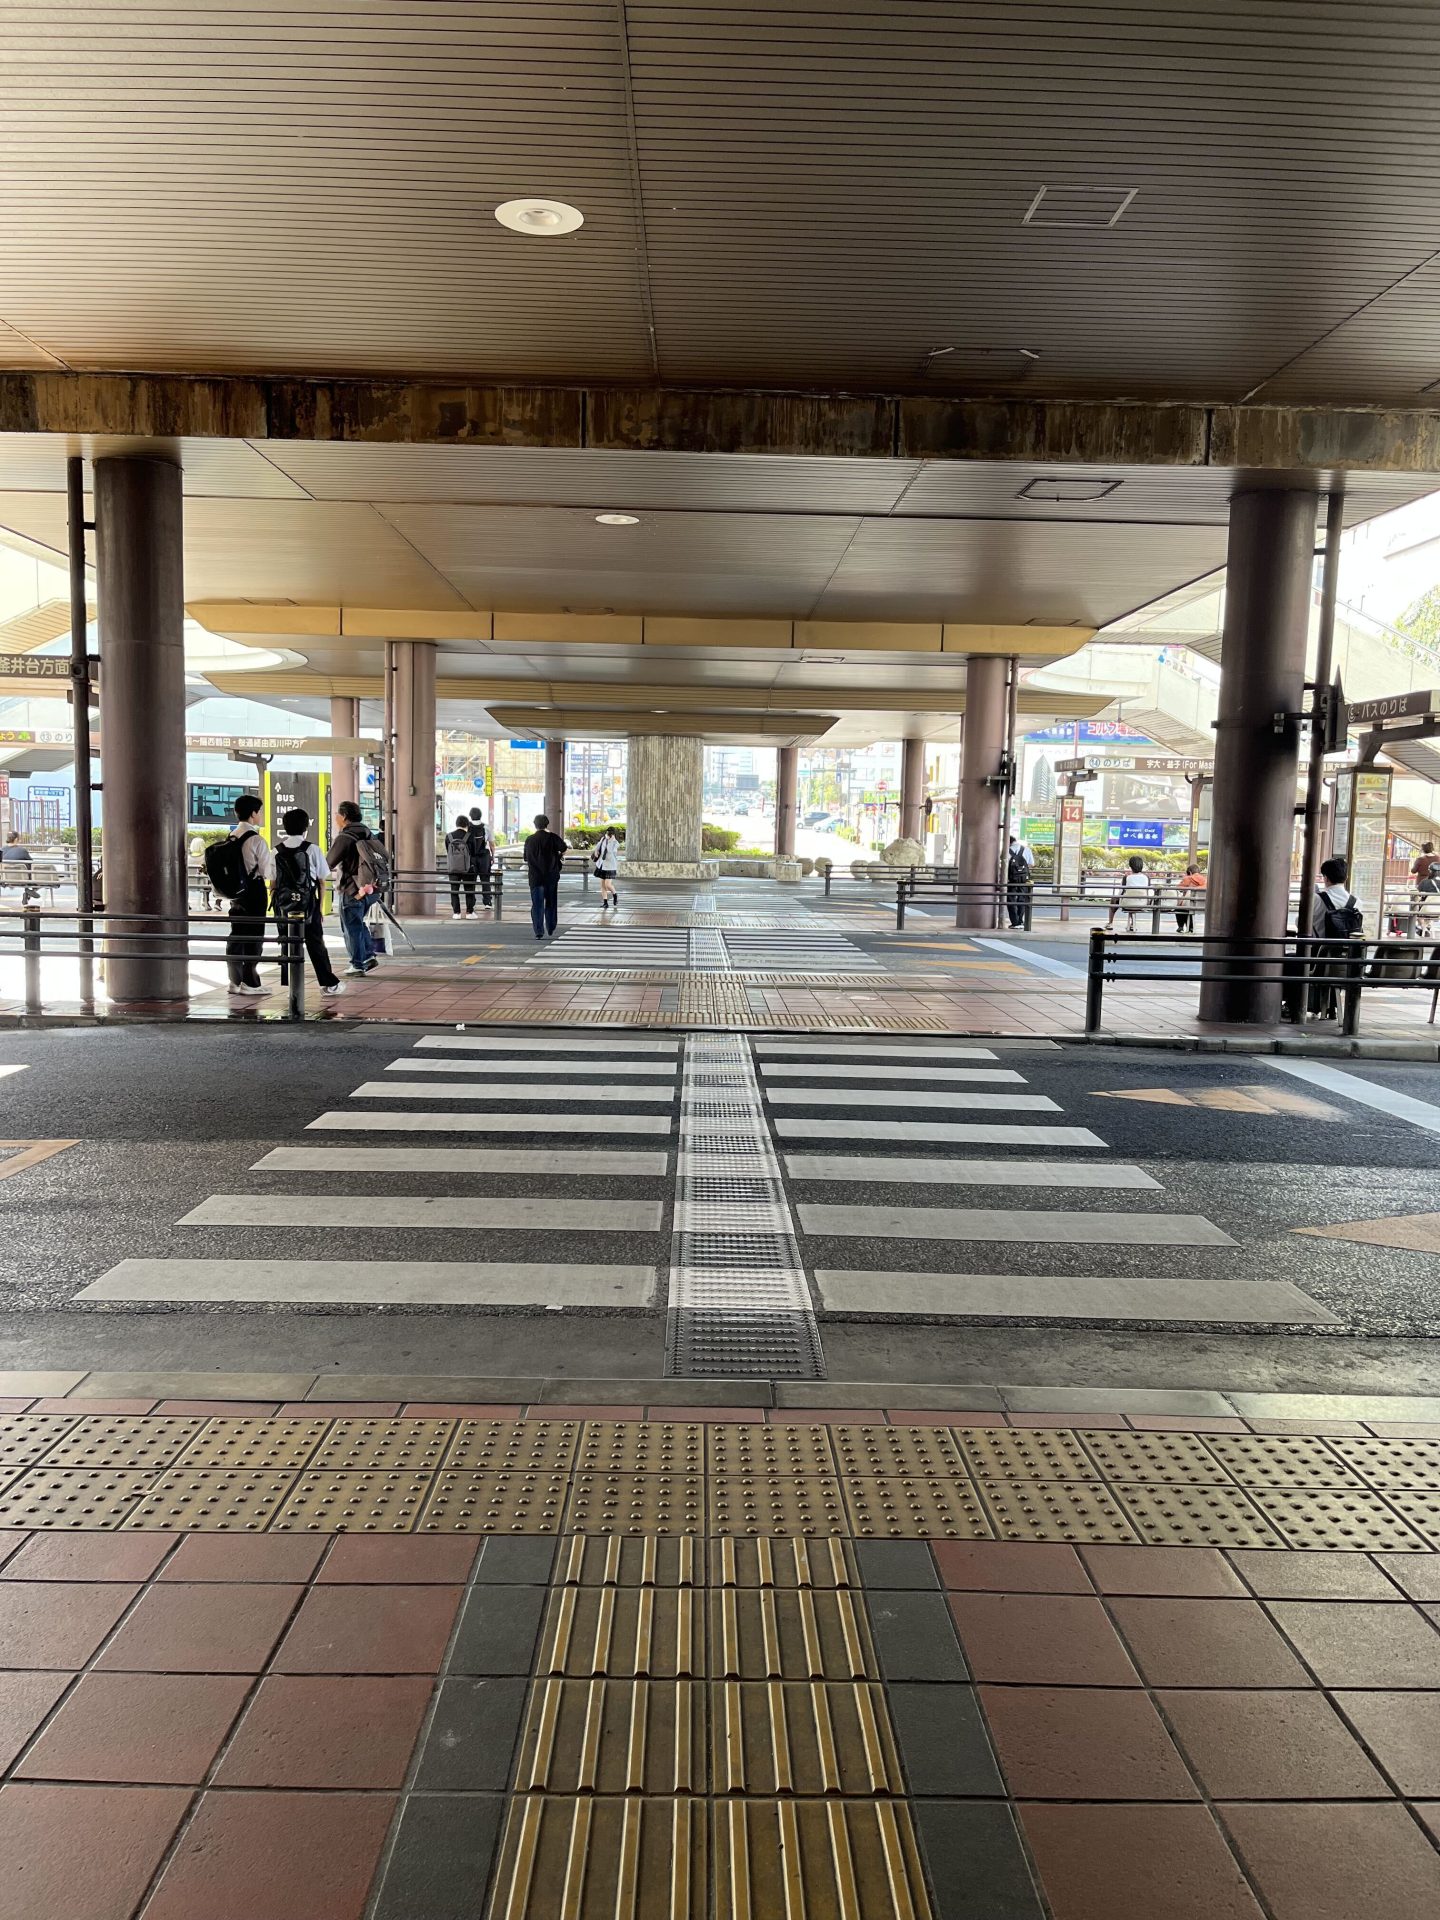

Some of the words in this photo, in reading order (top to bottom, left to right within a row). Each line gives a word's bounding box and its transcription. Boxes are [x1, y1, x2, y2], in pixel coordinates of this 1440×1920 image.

[0, 657, 70, 675] 釜井台方面
[276, 794, 295, 802] BUS
[1065, 807, 1081, 821] 14
[291, 892, 301, 902] 33
